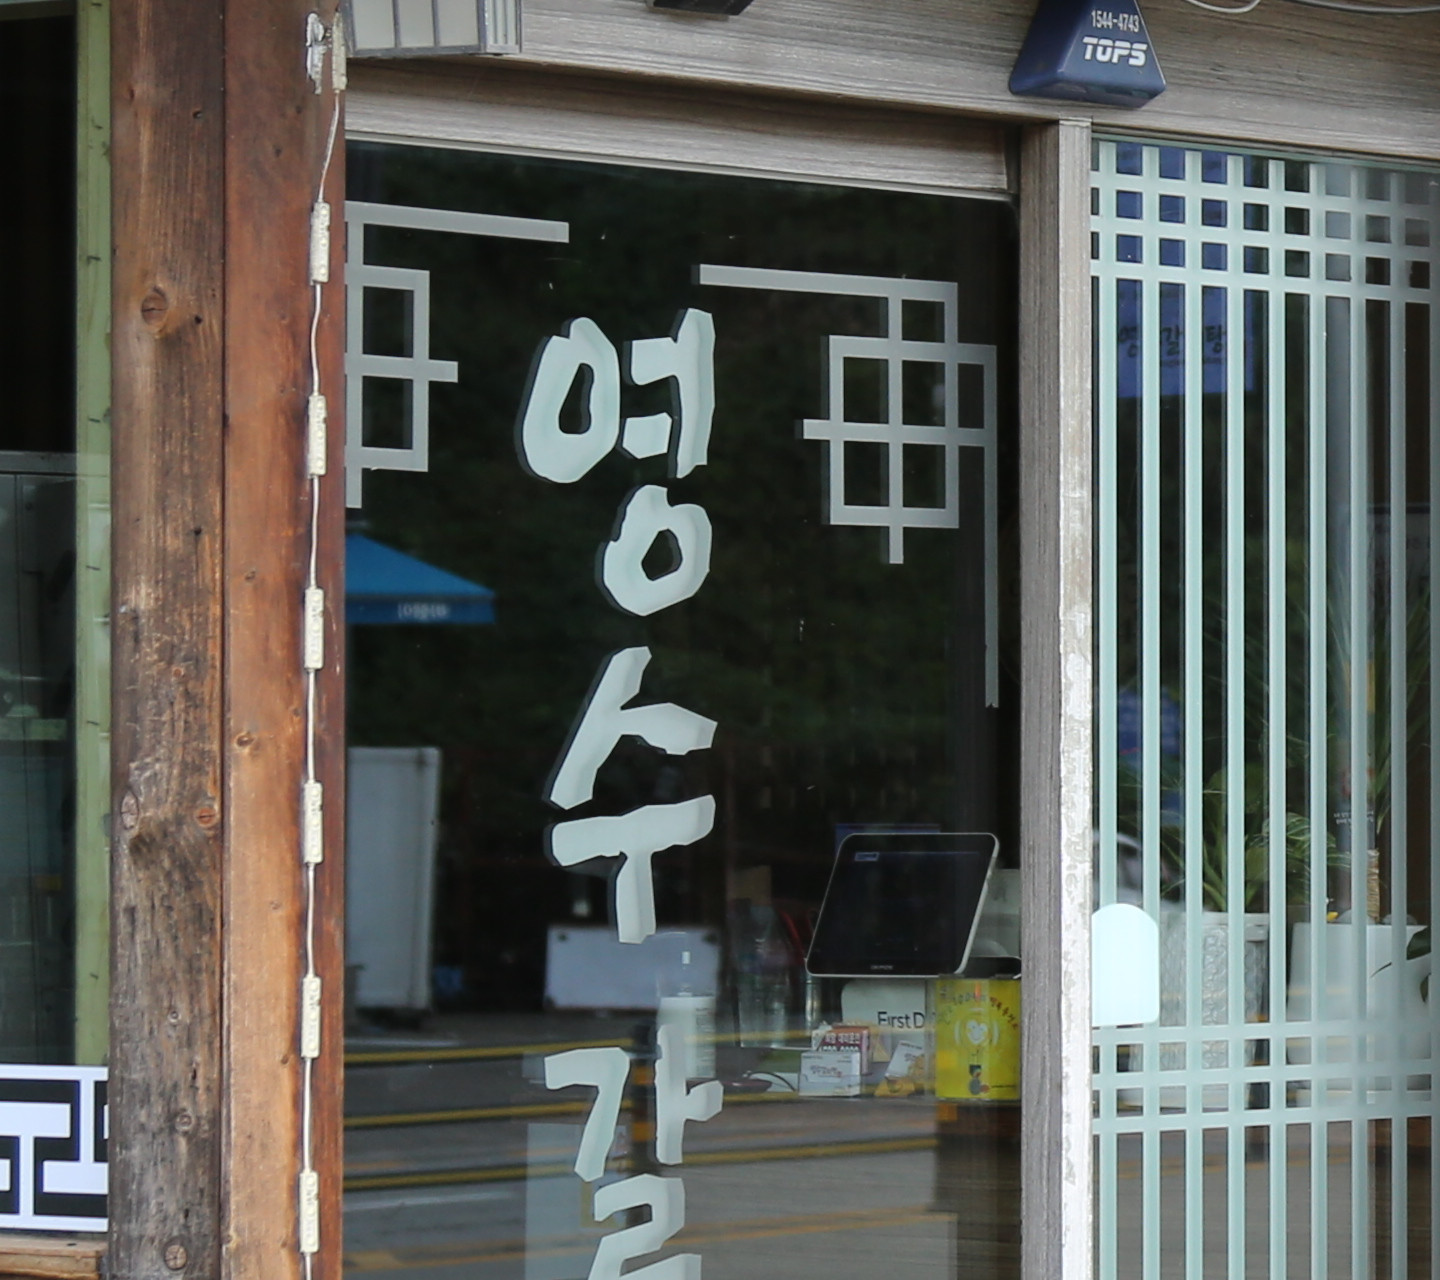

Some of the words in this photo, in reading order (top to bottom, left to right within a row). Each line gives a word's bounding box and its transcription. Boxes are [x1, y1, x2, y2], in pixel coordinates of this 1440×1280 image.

[1090, 9, 1140, 33] 1544-4743
[1082, 36, 1148, 66] TOPS
[878, 1011, 912, 1029] First
